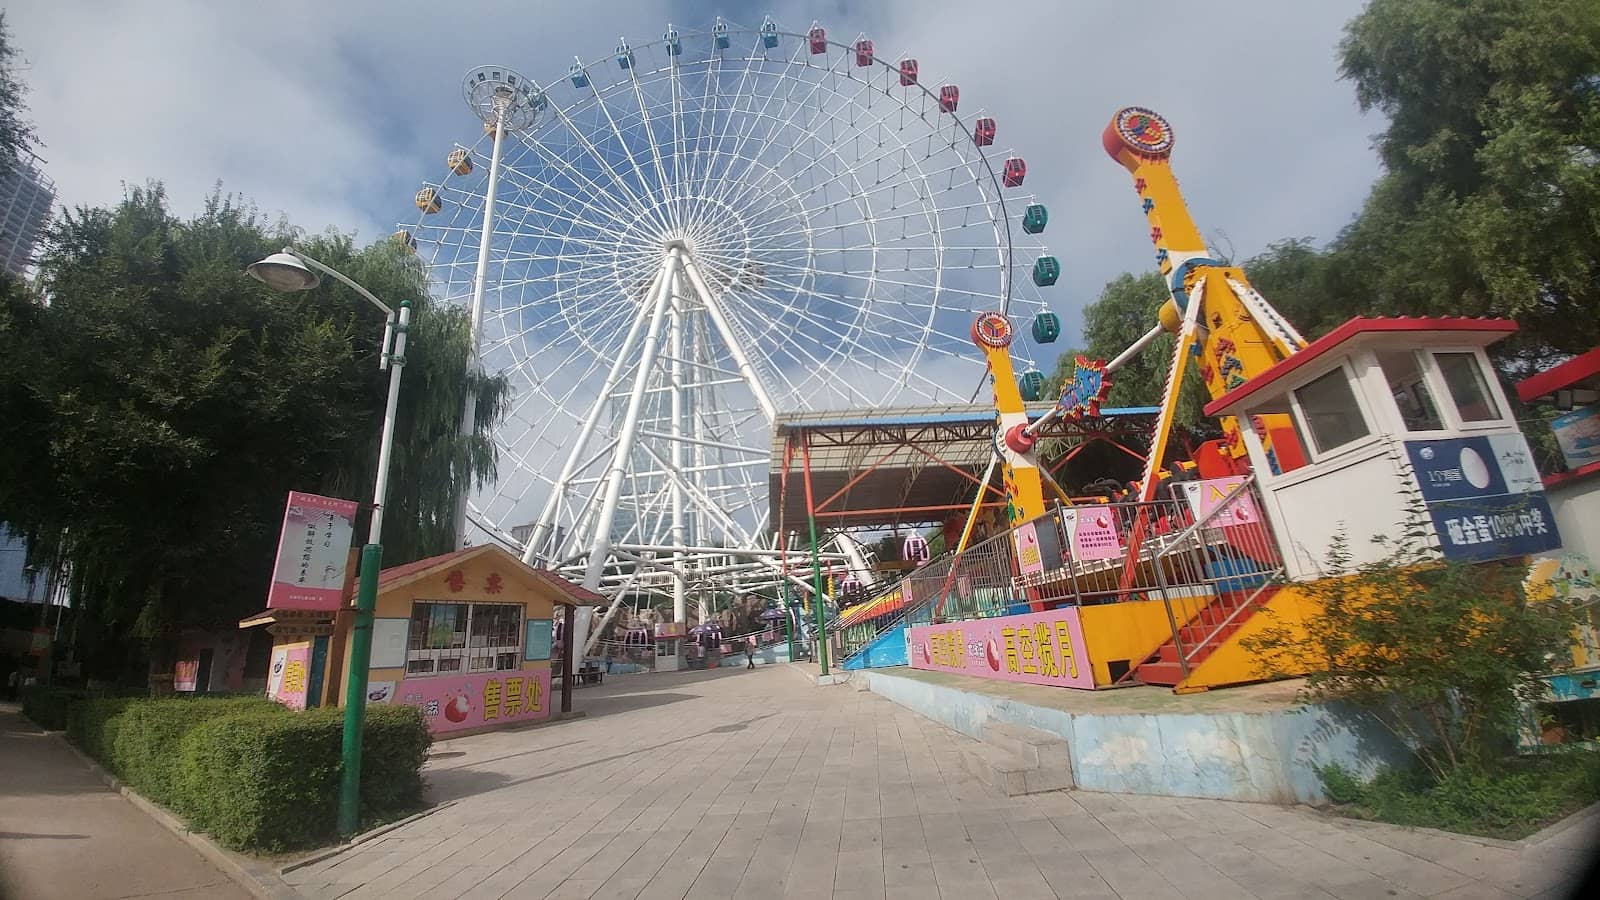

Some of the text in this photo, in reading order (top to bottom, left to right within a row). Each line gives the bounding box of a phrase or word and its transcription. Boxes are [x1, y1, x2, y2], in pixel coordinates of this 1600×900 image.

[444, 569, 505, 595] 售票
[1001, 620, 1079, 679] 高空揽月
[482, 676, 544, 721] 售票处
